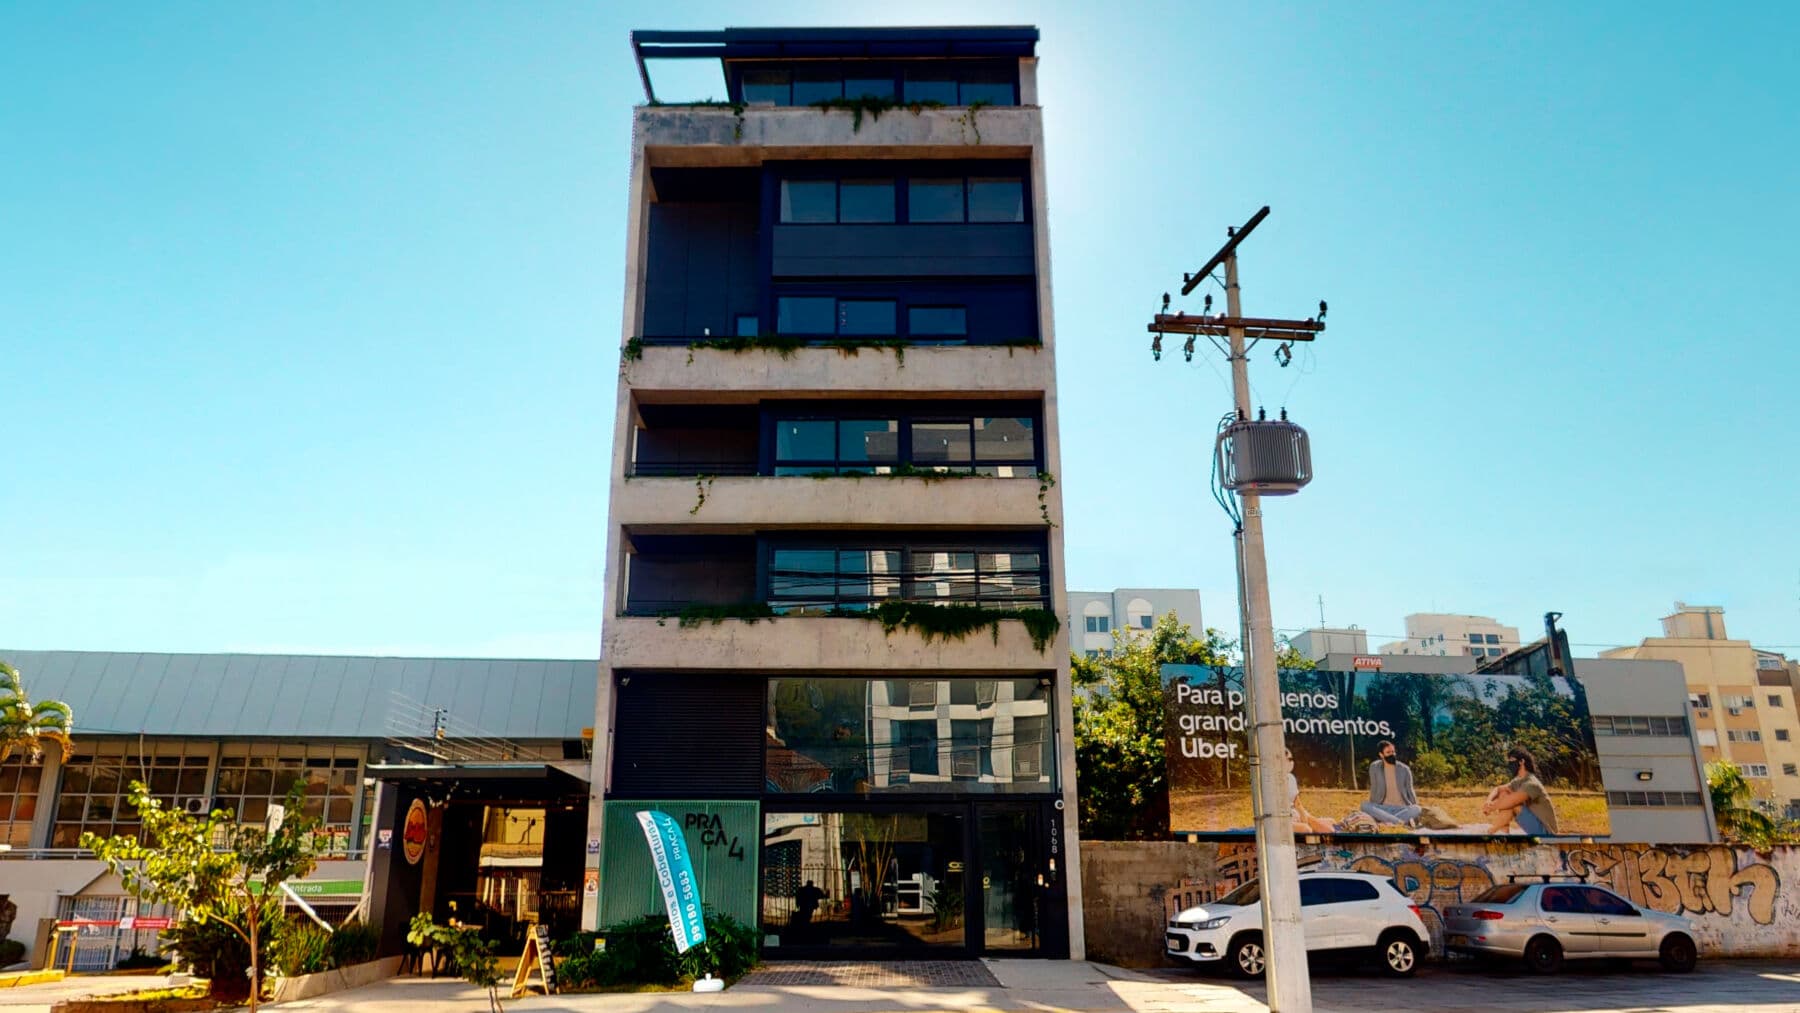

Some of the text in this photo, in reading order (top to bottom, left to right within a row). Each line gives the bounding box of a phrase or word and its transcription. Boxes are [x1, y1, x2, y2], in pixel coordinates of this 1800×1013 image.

[1355, 657, 1382, 666] ATIVA
[1177, 684, 1339, 710] Para penos
[1179, 712, 1397, 740] grand momentos,
[1180, 736, 1245, 760] Uber.
[662, 817, 671, 827] 4
[685, 813, 723, 830] PRA
[728, 836, 744, 862] 4
[1050, 819, 1058, 854] 1068
[646, 819, 671, 888] Coberturas
[670, 900, 686, 951] Studios
